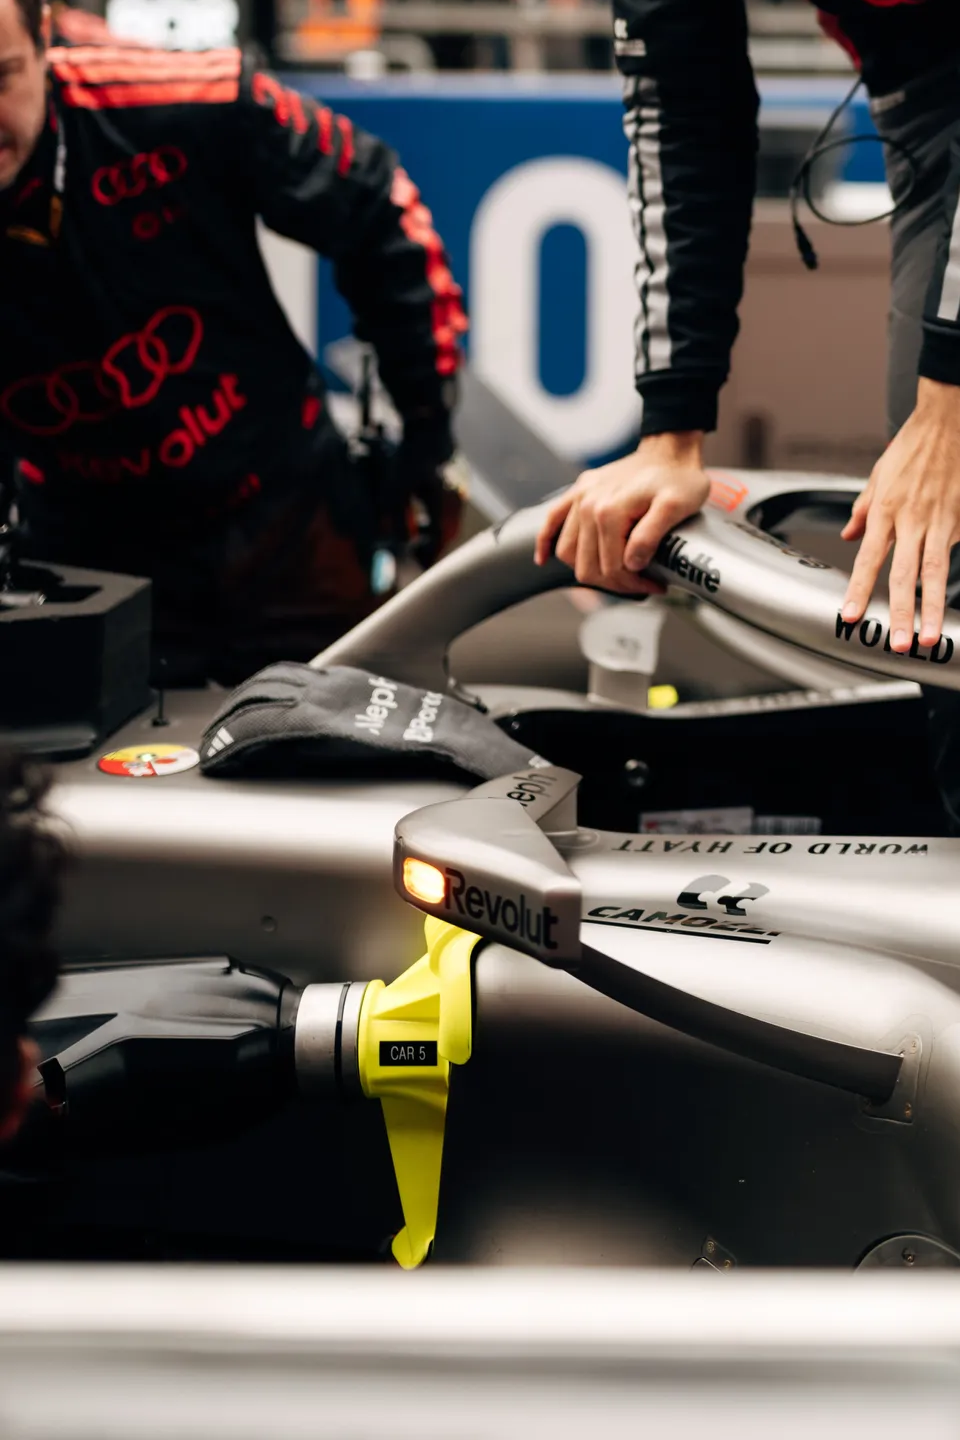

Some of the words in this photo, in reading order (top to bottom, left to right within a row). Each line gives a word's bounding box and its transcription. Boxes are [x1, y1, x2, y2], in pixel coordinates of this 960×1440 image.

[611, 839, 733, 854] HYATT
[744, 841, 793, 854] OF
[808, 841, 930, 857] WORLD
[444, 866, 559, 951] Revolut
[390, 1045, 416, 1062] CAR
[418, 1045, 427, 1062] 5
